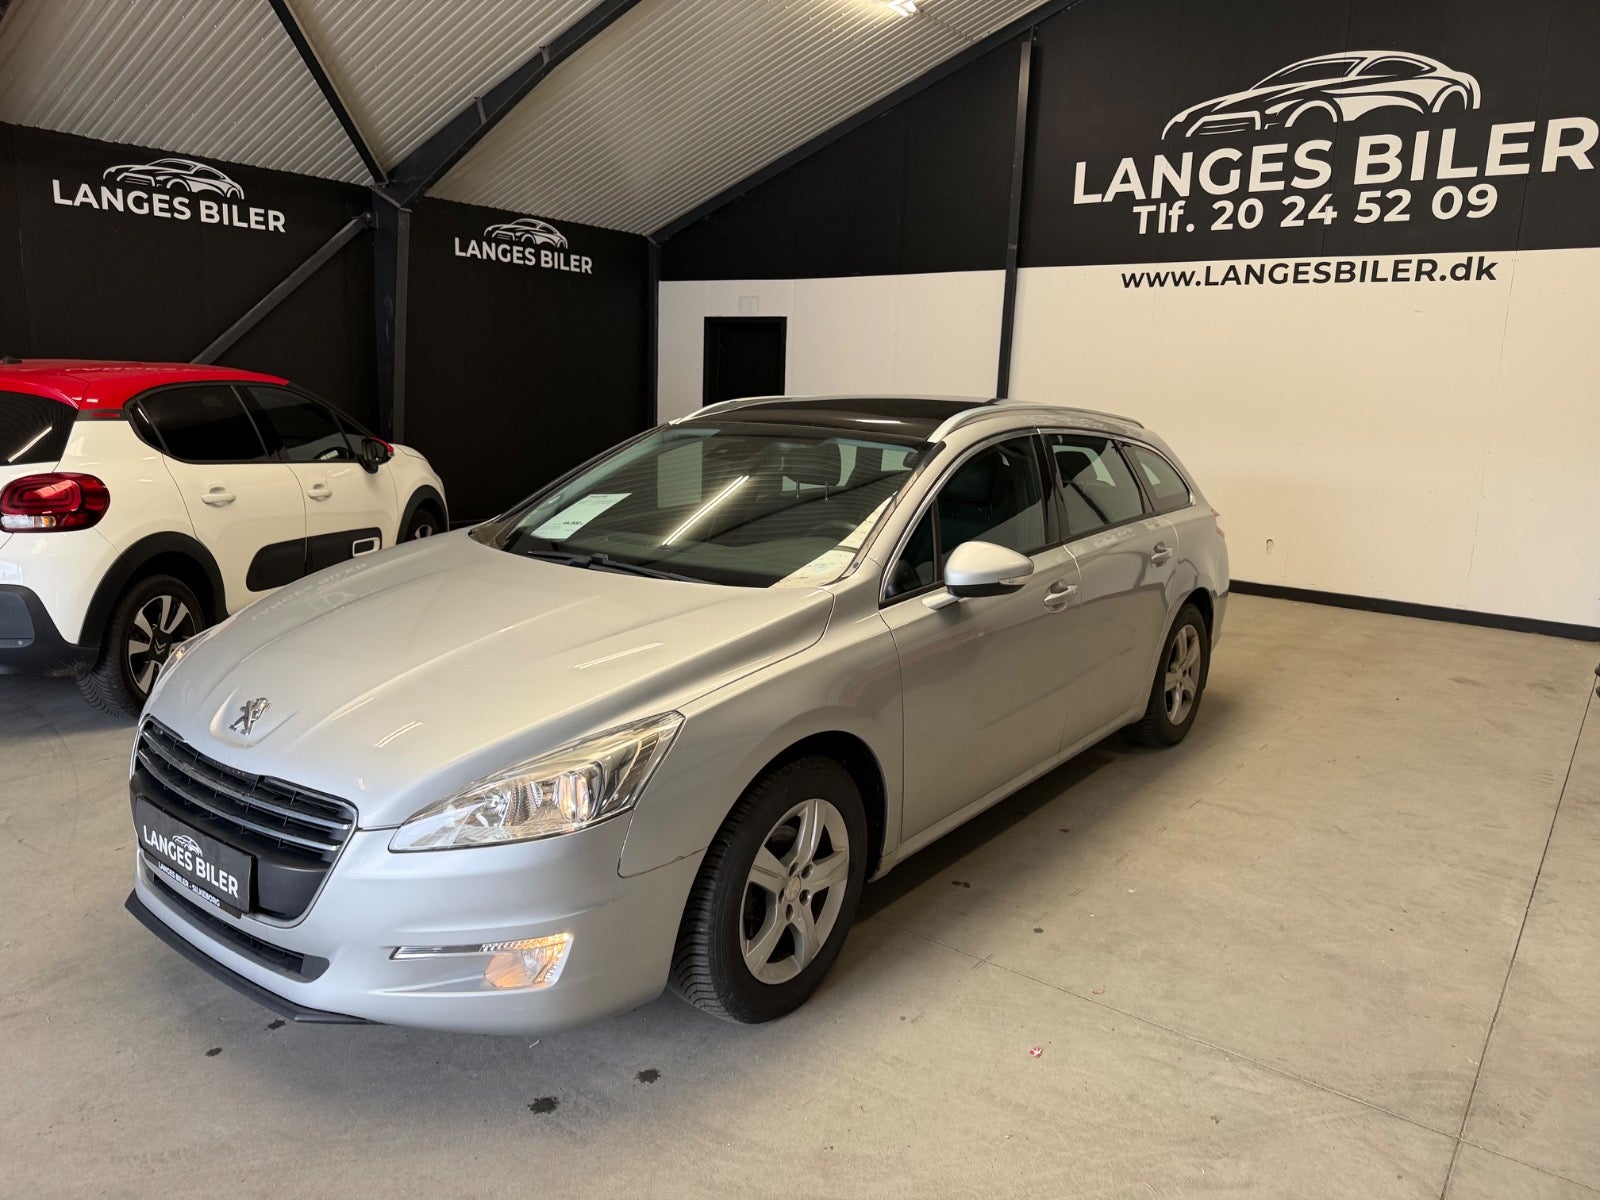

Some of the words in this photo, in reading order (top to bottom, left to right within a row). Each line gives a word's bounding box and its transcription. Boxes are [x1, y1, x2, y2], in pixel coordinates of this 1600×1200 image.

[1073, 139, 1333, 205] LANGES
[1353, 116, 1600, 186] BILER
[52, 179, 192, 221] LANGES
[199, 199, 286, 233] BILER
[1132, 199, 1195, 235] Tlf.
[1210, 197, 1264, 231] 20
[1279, 193, 1338, 228] 24
[1353, 188, 1412, 224] 52
[1431, 183, 1498, 220] 09
[454, 237, 536, 266] LANGES
[540, 249, 593, 274] BILER
[1121, 255, 1499, 289] www.LANGESBILER.dk
[143, 824, 193, 872] LANGES
[195, 856, 239, 899] BILER
